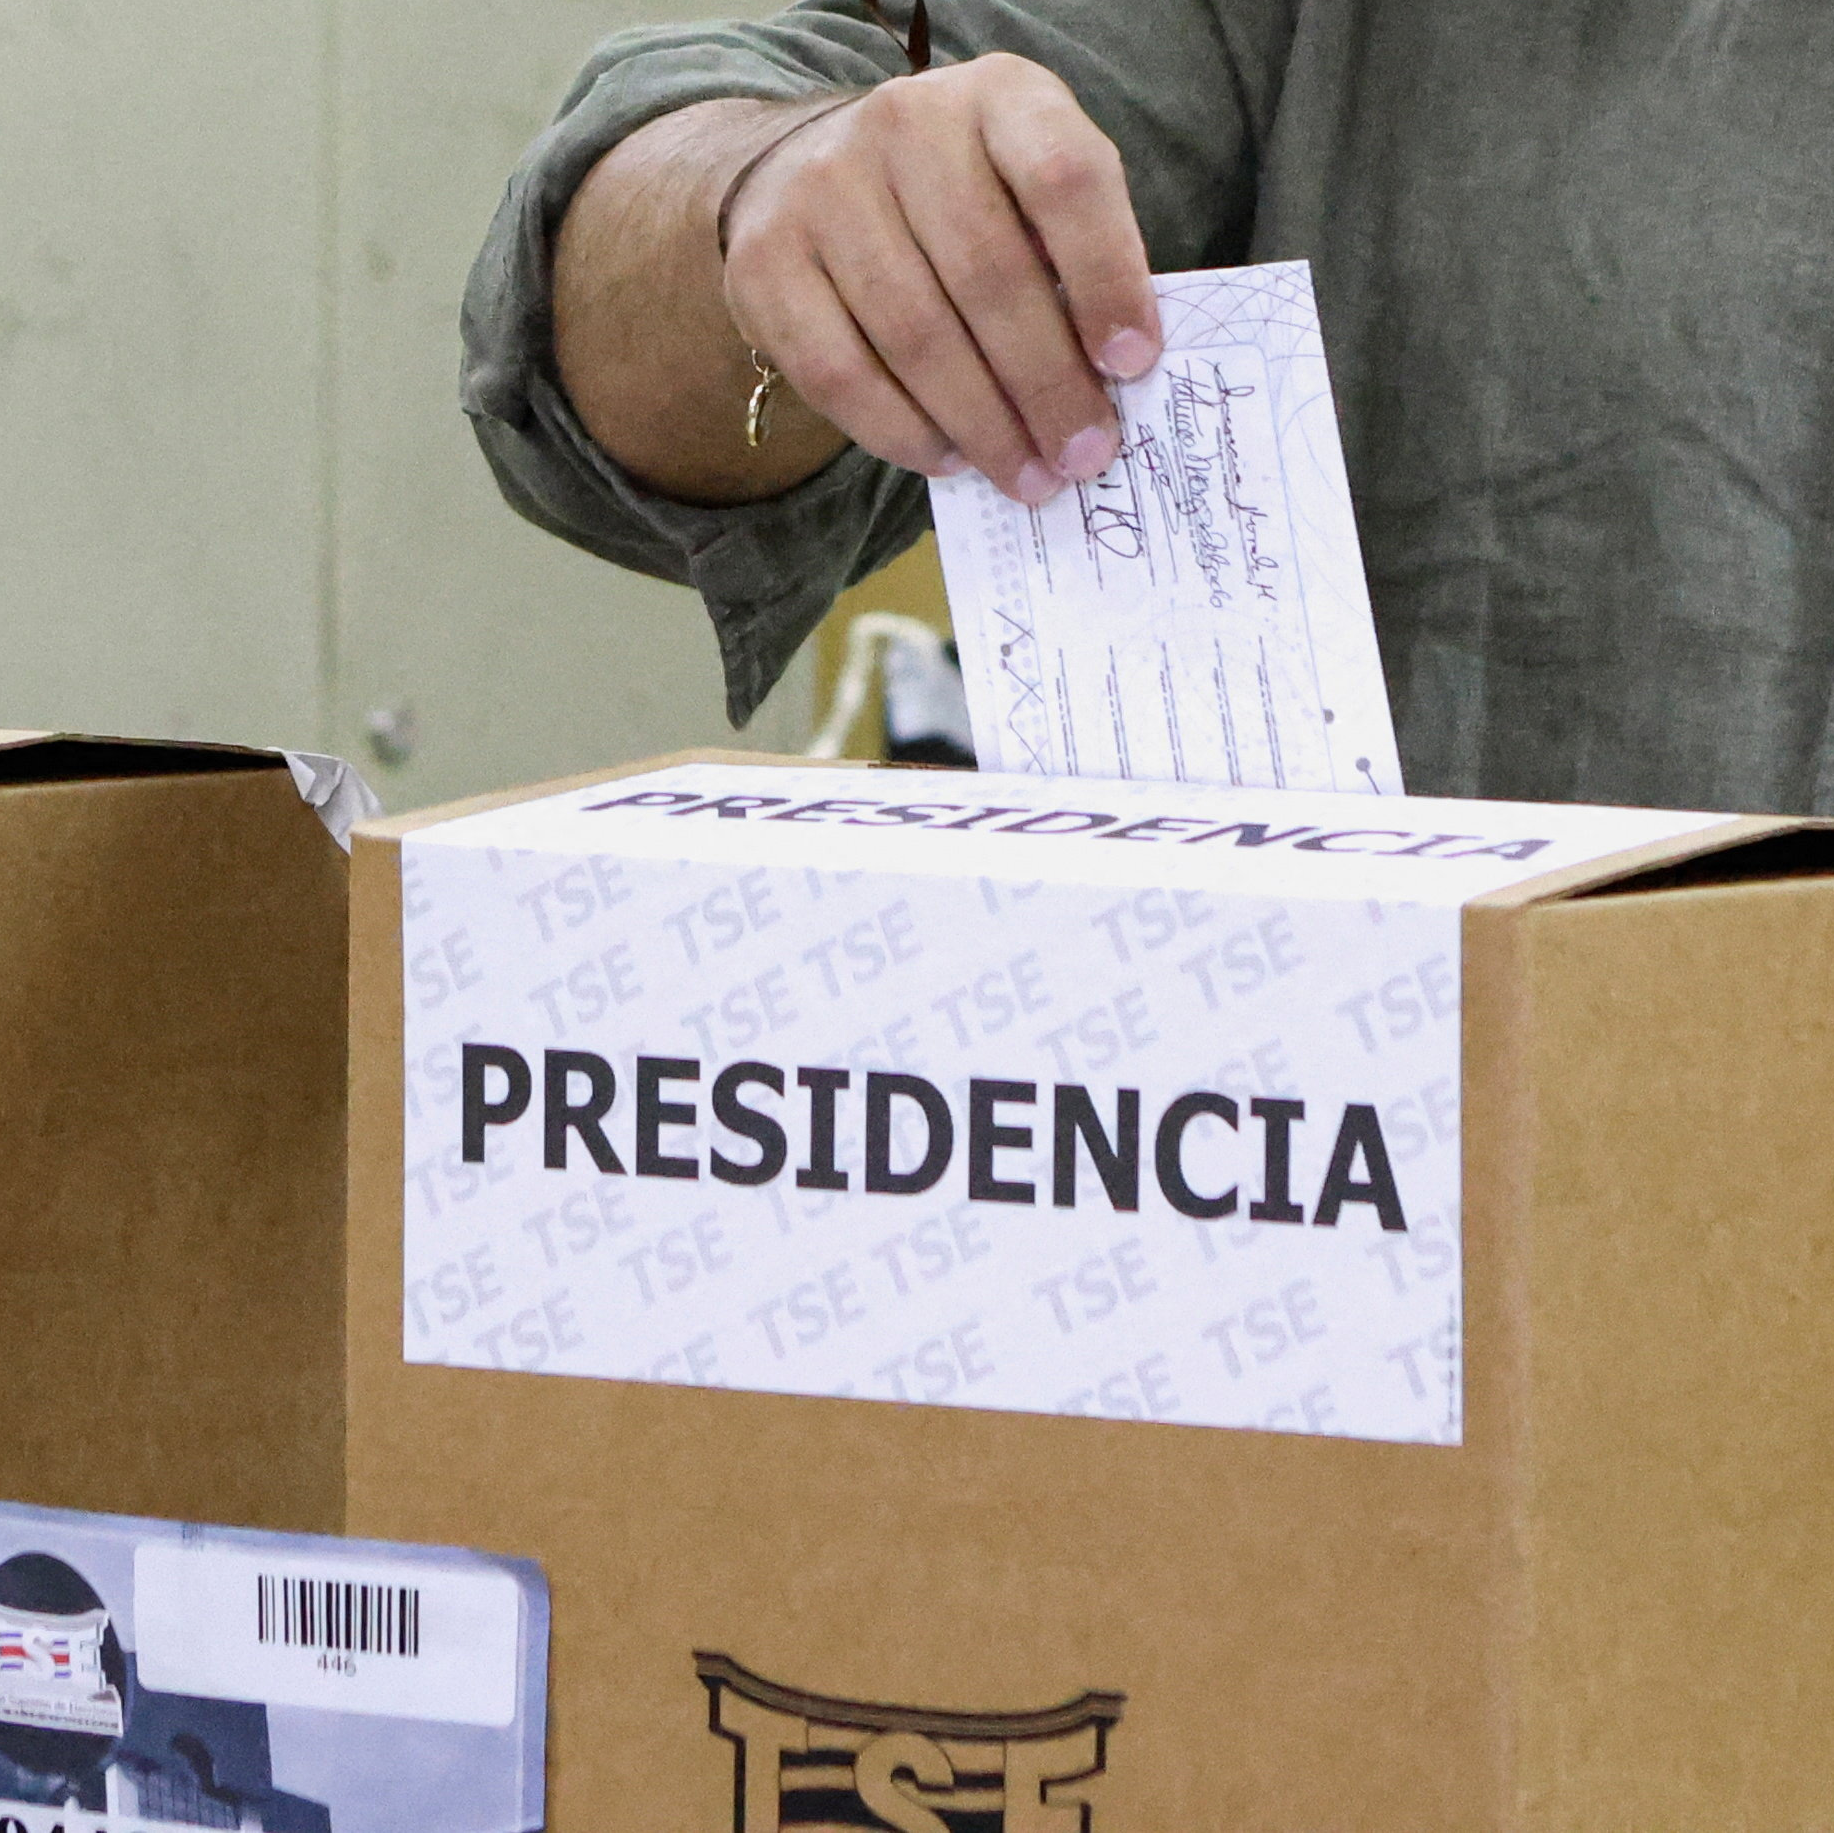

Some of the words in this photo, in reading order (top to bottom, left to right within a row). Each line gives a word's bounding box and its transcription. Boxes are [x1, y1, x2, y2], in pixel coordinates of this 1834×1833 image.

[580, 790, 1557, 862] PRESIDENCIA
[517, 853, 634, 943] TSE
[663, 867, 783, 965] TSE
[1091, 888, 1216, 964] TSE
[405, 929, 484, 1011] SE
[528, 941, 644, 1039] TSE
[802, 900, 924, 998] TSE
[1180, 907, 1306, 1012] TSE
[681, 965, 800, 1064] TSE
[931, 951, 1053, 1050] TSE
[1036, 986, 1159, 1084] TSE
[1337, 953, 1461, 1055] TSE
[462, 1042, 1409, 1233] PRESIDENCIA
[1380, 1075, 1460, 1164] SE
[523, 1176, 635, 1268] TSE
[618, 1211, 734, 1305] TSE
[872, 1204, 990, 1297] TSE
[1365, 1201, 1460, 1296] TS
[748, 1261, 866, 1359] TSE
[1032, 1237, 1158, 1336] TSE
[1201, 1277, 1328, 1380] TSE
[317, 1653, 357, 1678] 446
